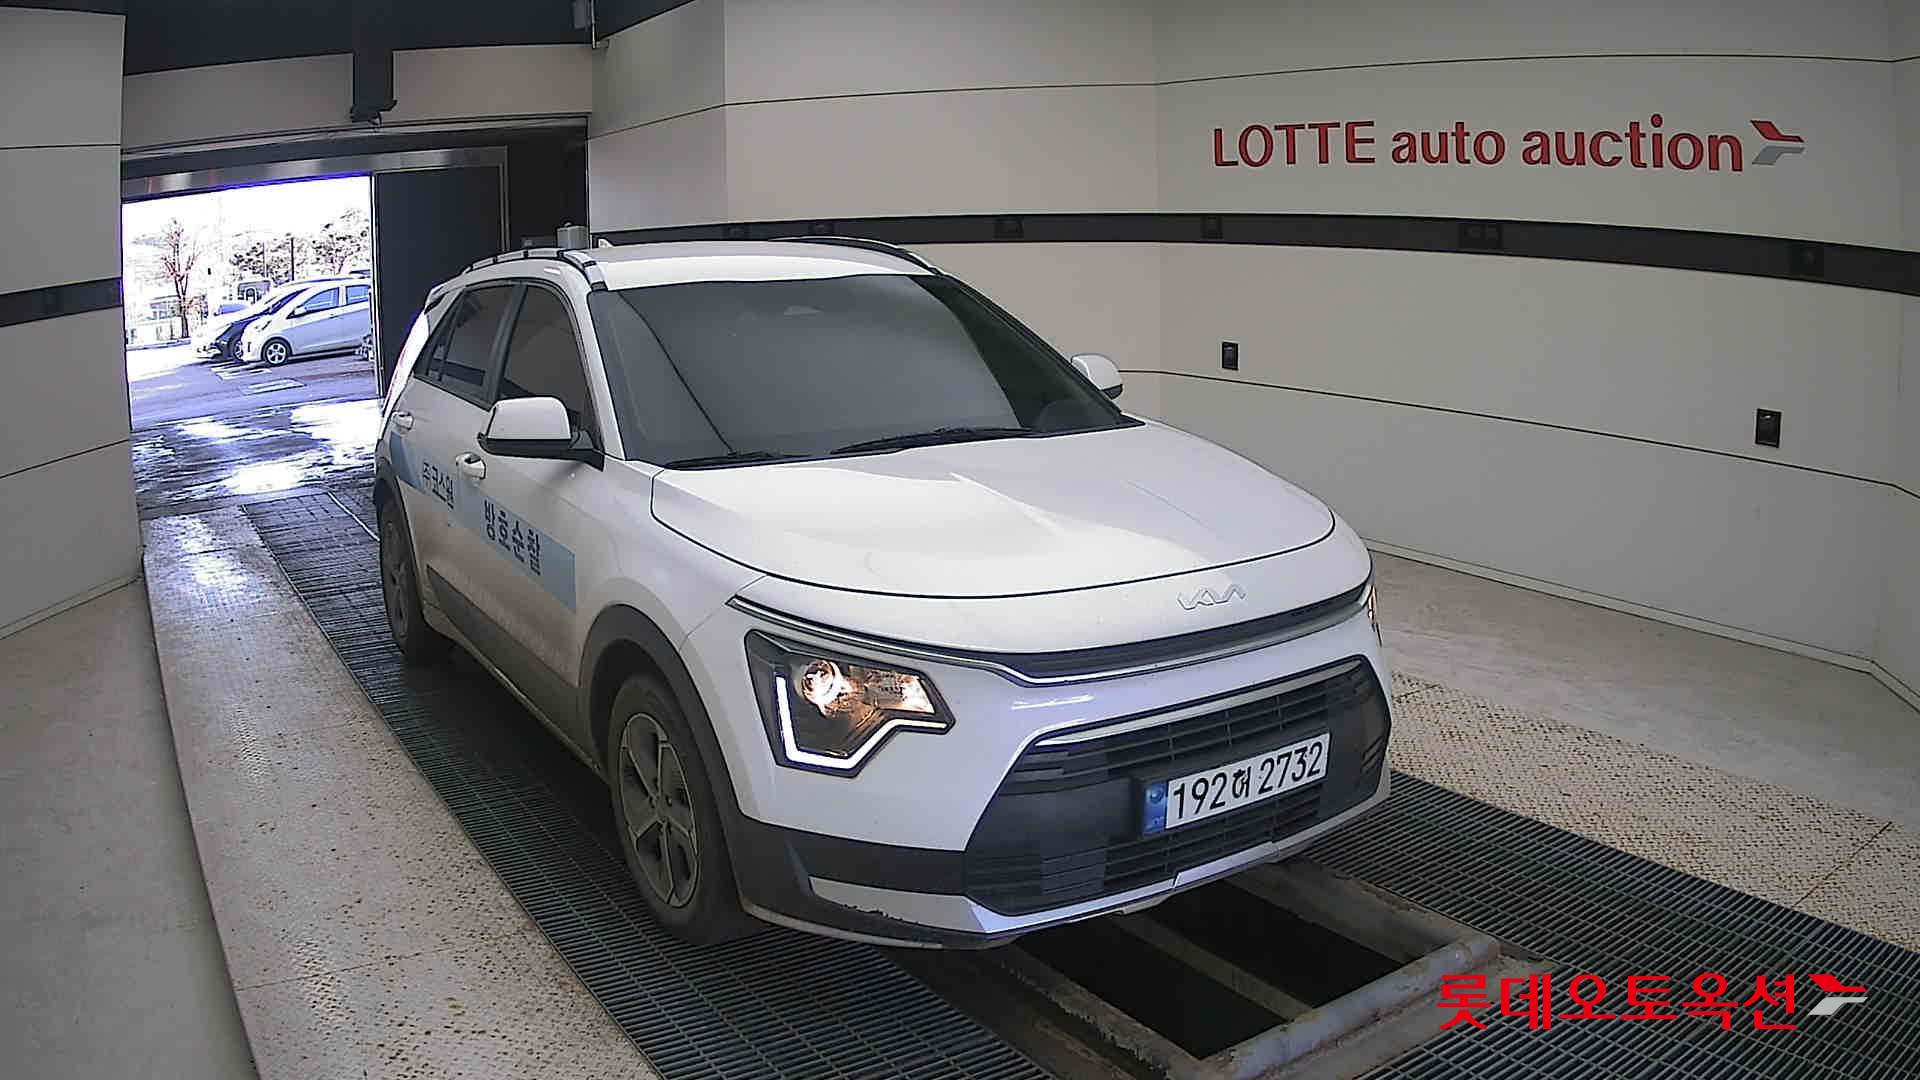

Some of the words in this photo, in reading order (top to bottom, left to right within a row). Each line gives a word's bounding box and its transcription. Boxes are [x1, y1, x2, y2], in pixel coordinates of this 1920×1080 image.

[1212, 119, 1376, 167] LOTTE
[1391, 121, 1505, 166] auto
[1522, 113, 1744, 173] auction
[483, 499, 542, 577] 방호순찰
[1173, 766, 1252, 819] 192허
[1257, 741, 1323, 796] 2732
